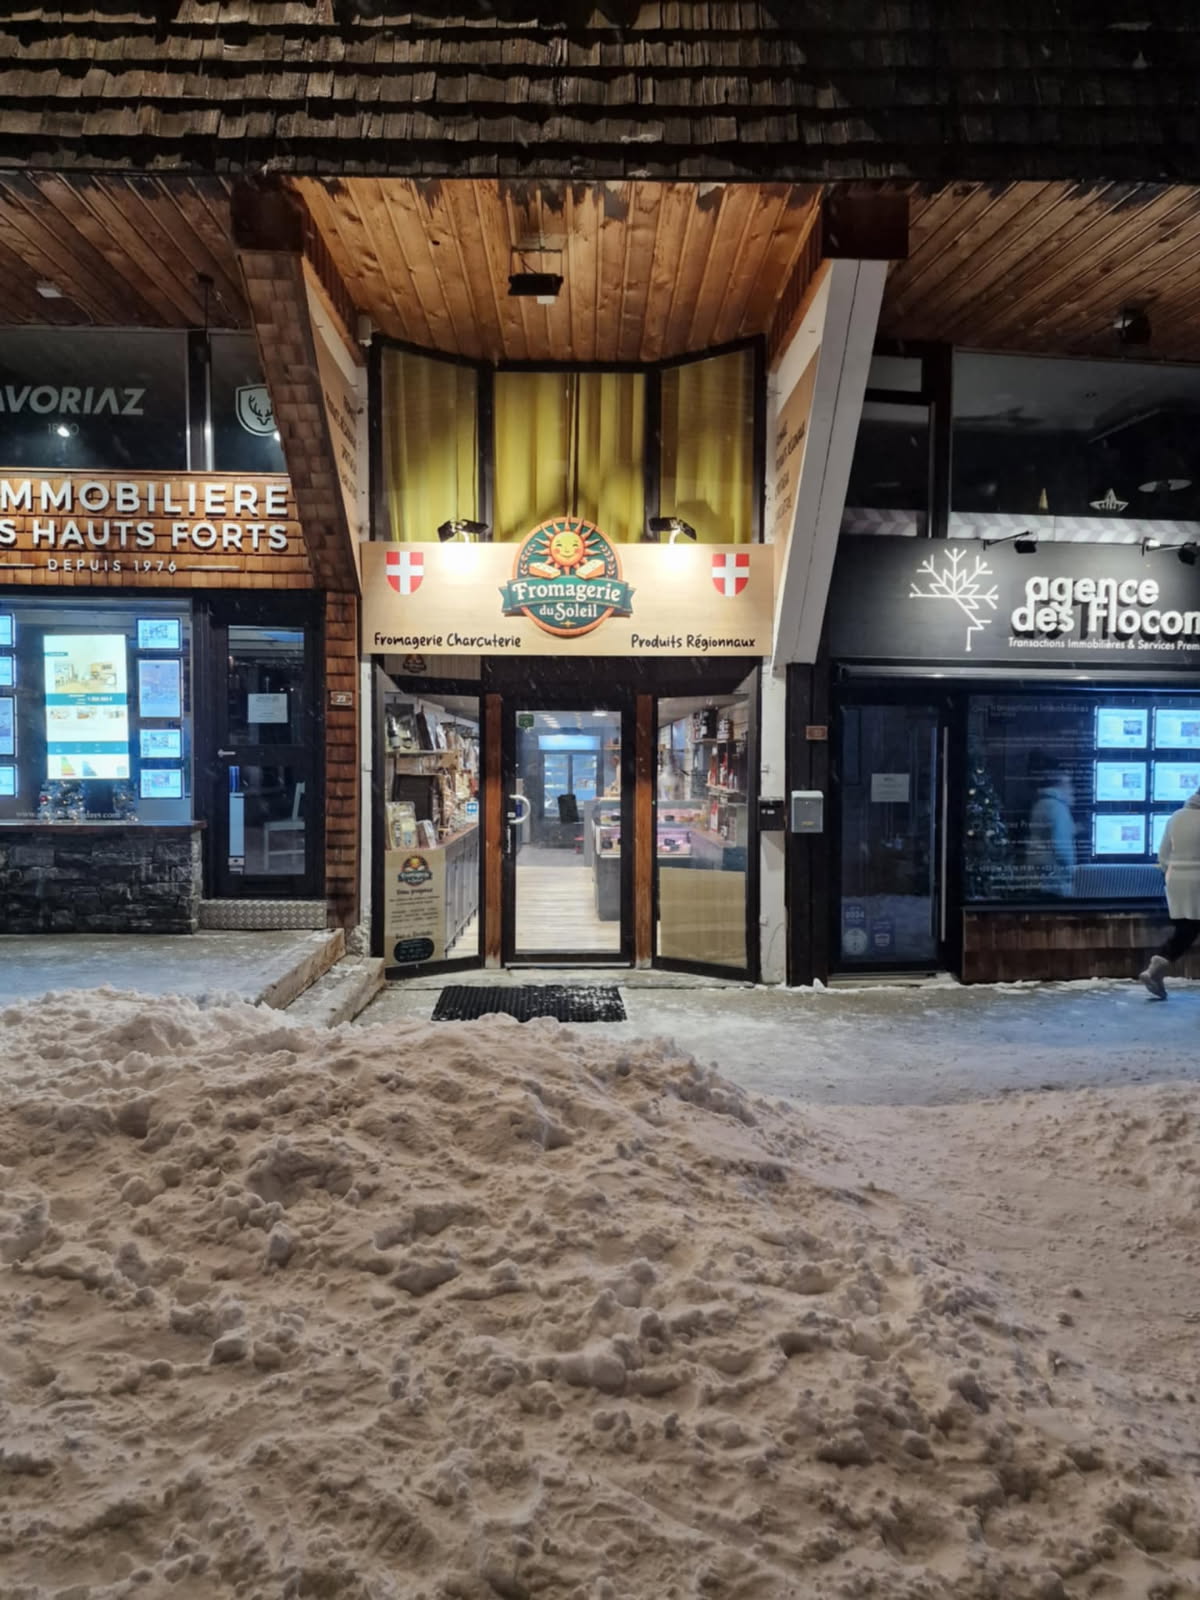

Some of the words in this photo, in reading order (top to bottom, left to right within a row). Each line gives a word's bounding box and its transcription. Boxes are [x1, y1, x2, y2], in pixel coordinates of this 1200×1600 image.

[0, 385, 147, 416] VORIAZ
[1, 480, 288, 516] MMOBILIERE
[33, 520, 156, 547] HAUTS
[172, 523, 289, 550] FORTS
[48, 559, 122, 572] DEPUIS
[134, 560, 178, 573] 1976
[512, 581, 622, 604] Fromagerie
[1026, 576, 1159, 612] agence
[539, 605, 555, 618] du
[555, 602, 598, 620] Soleil
[1012, 604, 1075, 633] des
[373, 631, 443, 649] Fromagerie
[447, 632, 522, 648] Charcuterie
[631, 634, 682, 648] Produits
[687, 634, 756, 651] Régionnaux
[1009, 637, 1065, 648] Transactions
[1067, 638, 1126, 650] Immobilières
[1127, 639, 1137, 649] &
[1138, 639, 1175, 650] Services
[1177, 640, 1200, 651] Prem
